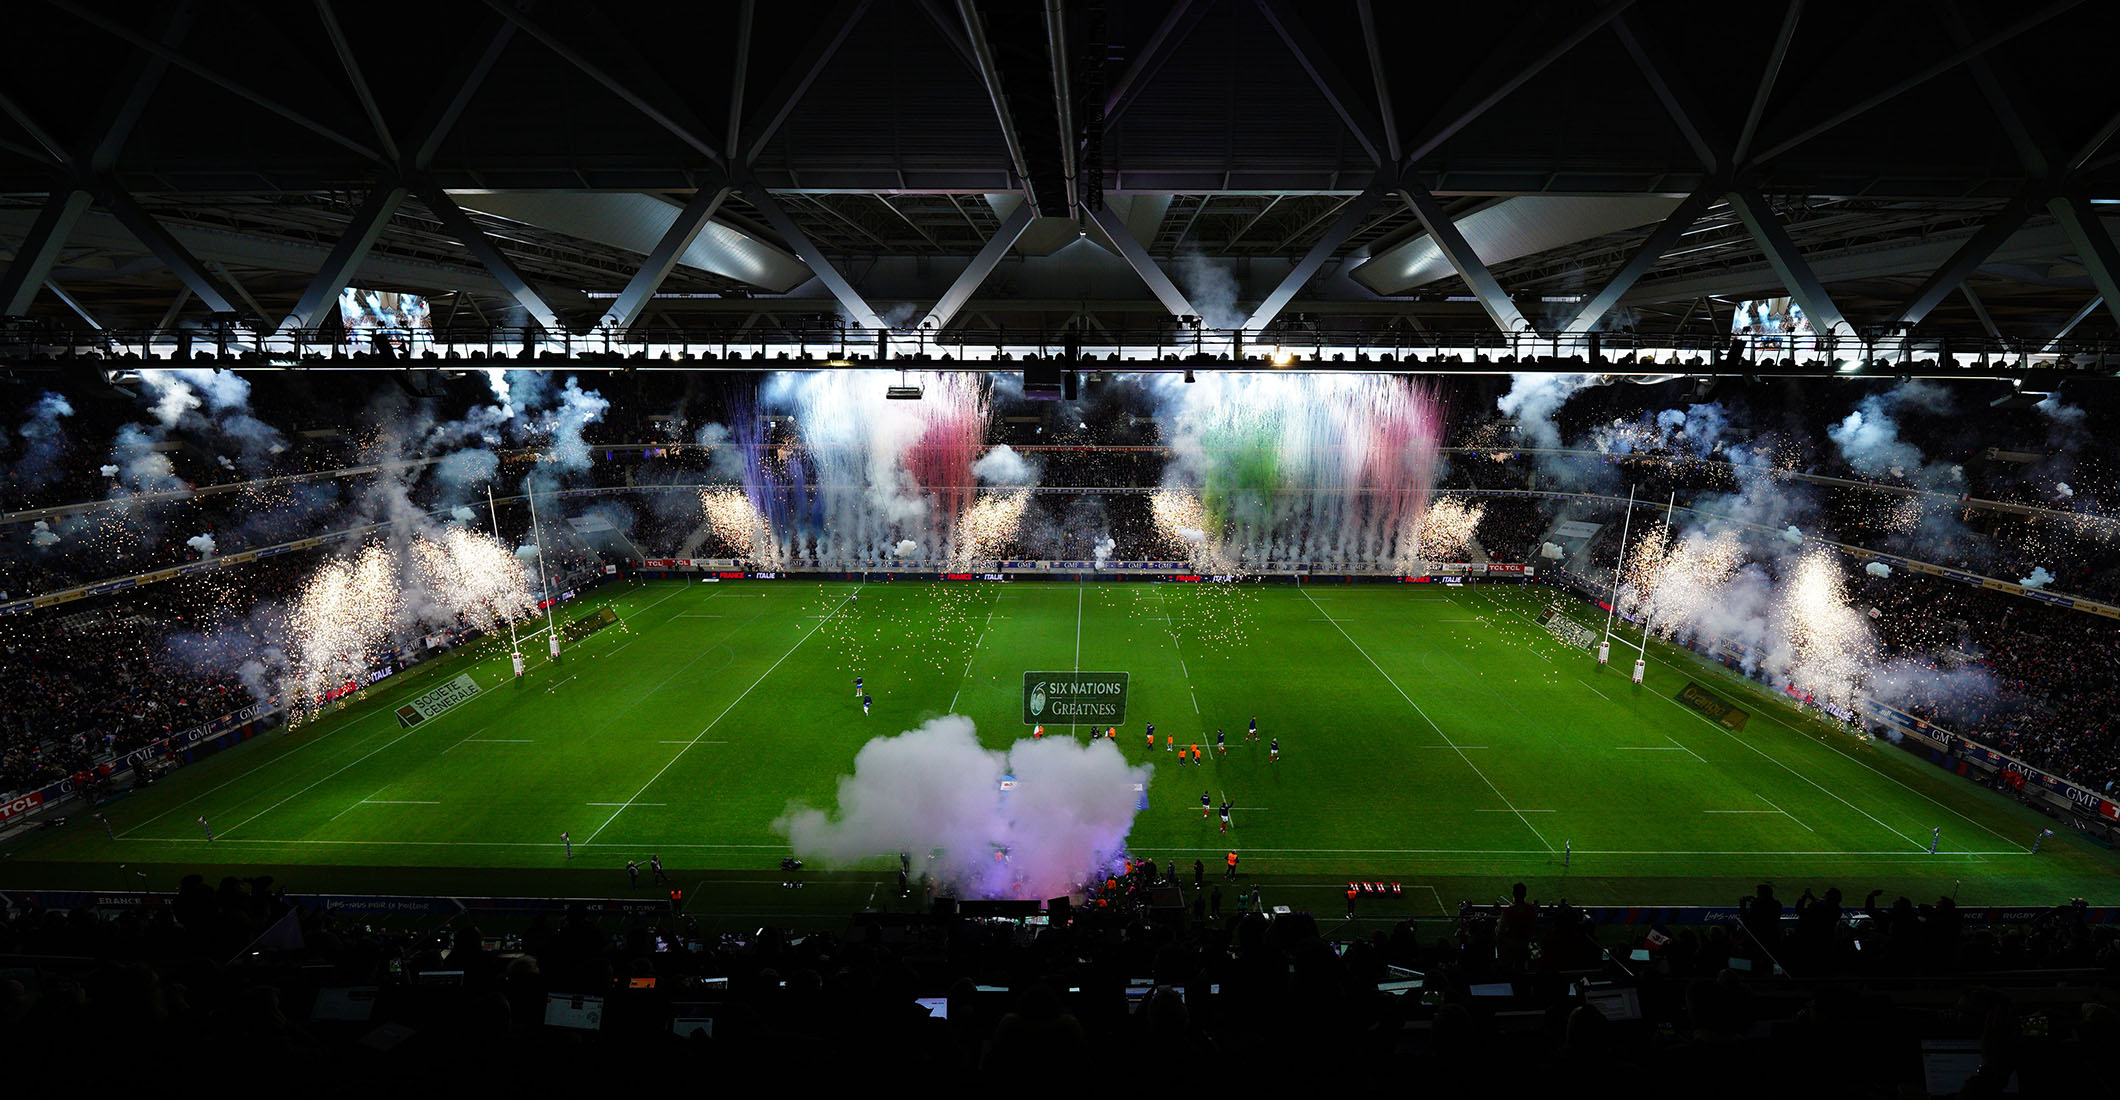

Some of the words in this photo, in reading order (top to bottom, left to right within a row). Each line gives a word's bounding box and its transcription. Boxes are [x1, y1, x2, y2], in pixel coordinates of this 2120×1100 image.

[371, 665, 393, 682] ITALIE
[1049, 682, 1068, 695] SIX
[1070, 682, 1121, 695] NATIONS
[0, 796, 38, 817] TCL
[2065, 786, 2100, 808] GMF
